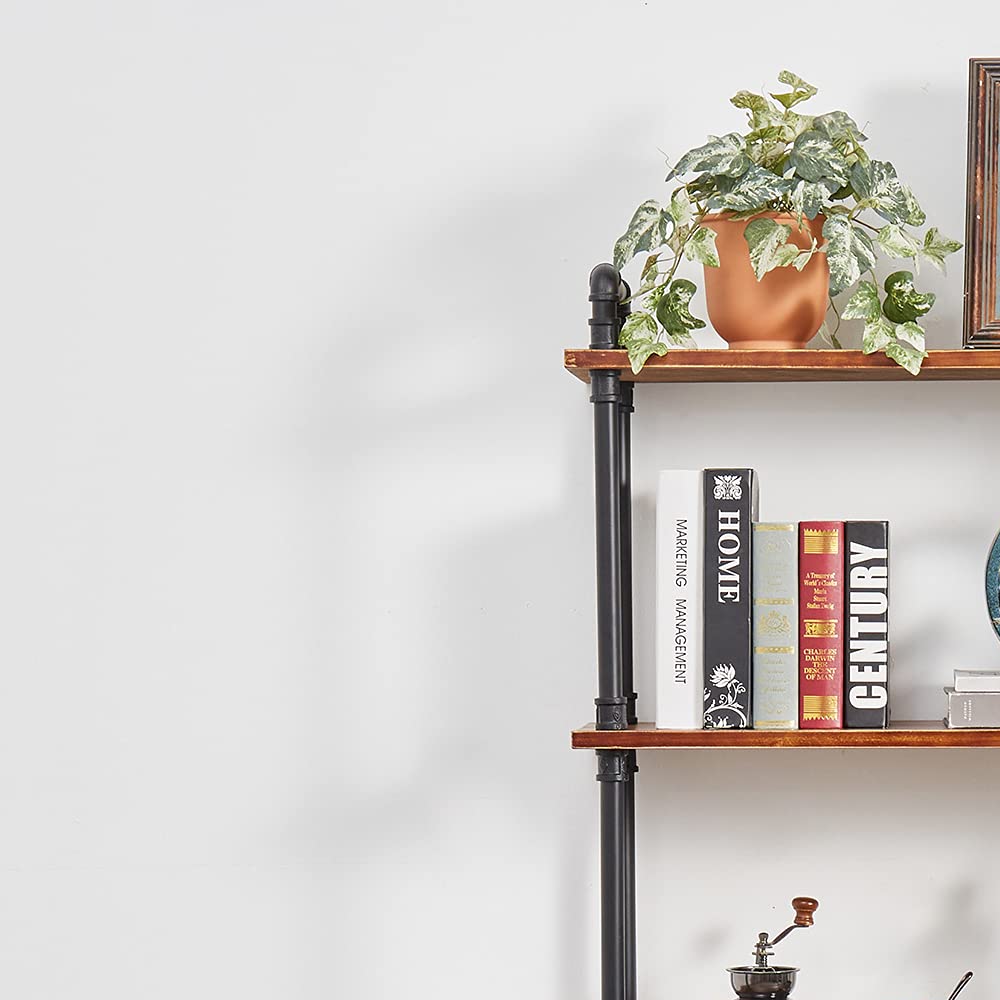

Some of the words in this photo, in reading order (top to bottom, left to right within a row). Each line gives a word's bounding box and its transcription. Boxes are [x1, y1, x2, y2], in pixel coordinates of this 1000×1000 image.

[675, 519, 688, 588] MARKETING
[717, 509, 741, 604] HOME
[674, 598, 687, 685] MANAGEMENT
[849, 541, 888, 710] CENTURY
[816, 673, 834, 681] MAN
